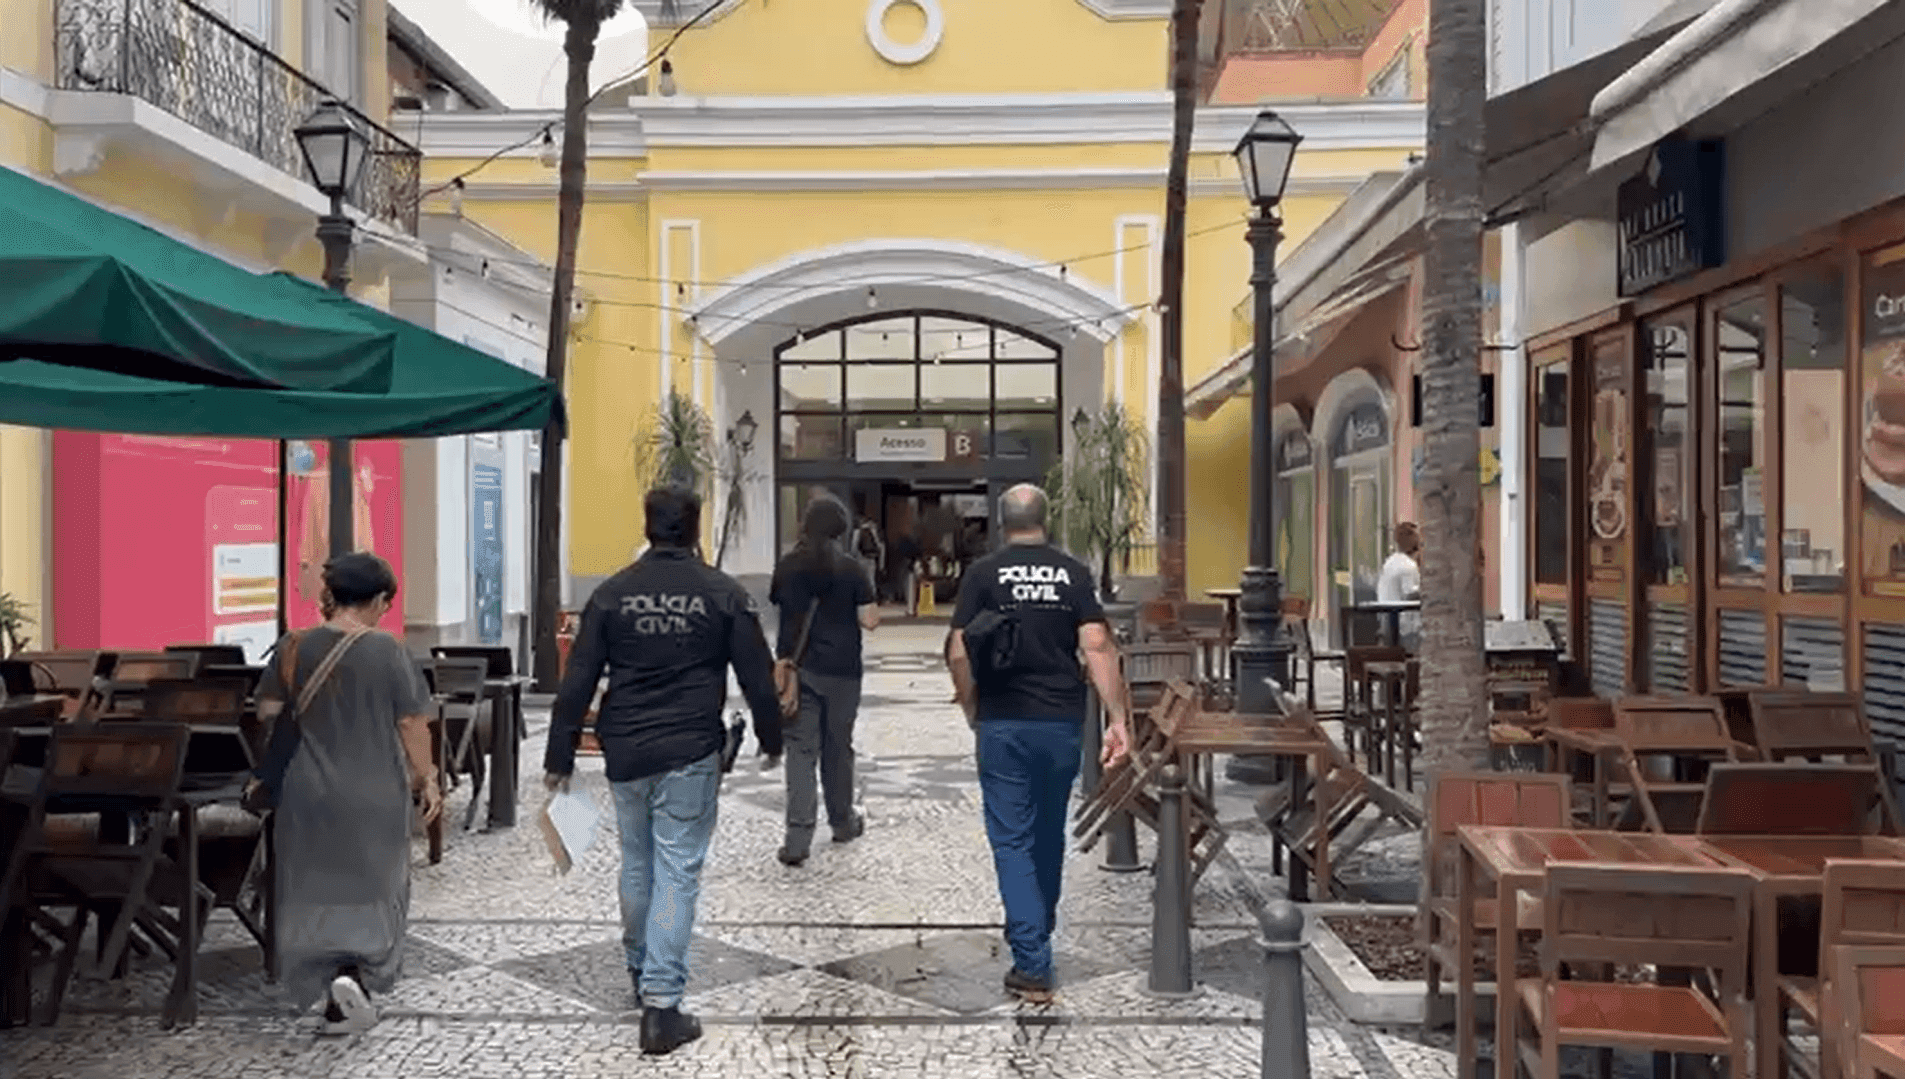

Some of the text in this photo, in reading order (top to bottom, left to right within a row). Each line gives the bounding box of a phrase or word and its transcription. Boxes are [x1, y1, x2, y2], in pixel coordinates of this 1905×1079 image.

[880, 436, 926, 449] Acesso
[954, 435, 972, 456] B
[1011, 584, 1061, 602] CIVIL
[634, 615, 694, 635] CIVIL
